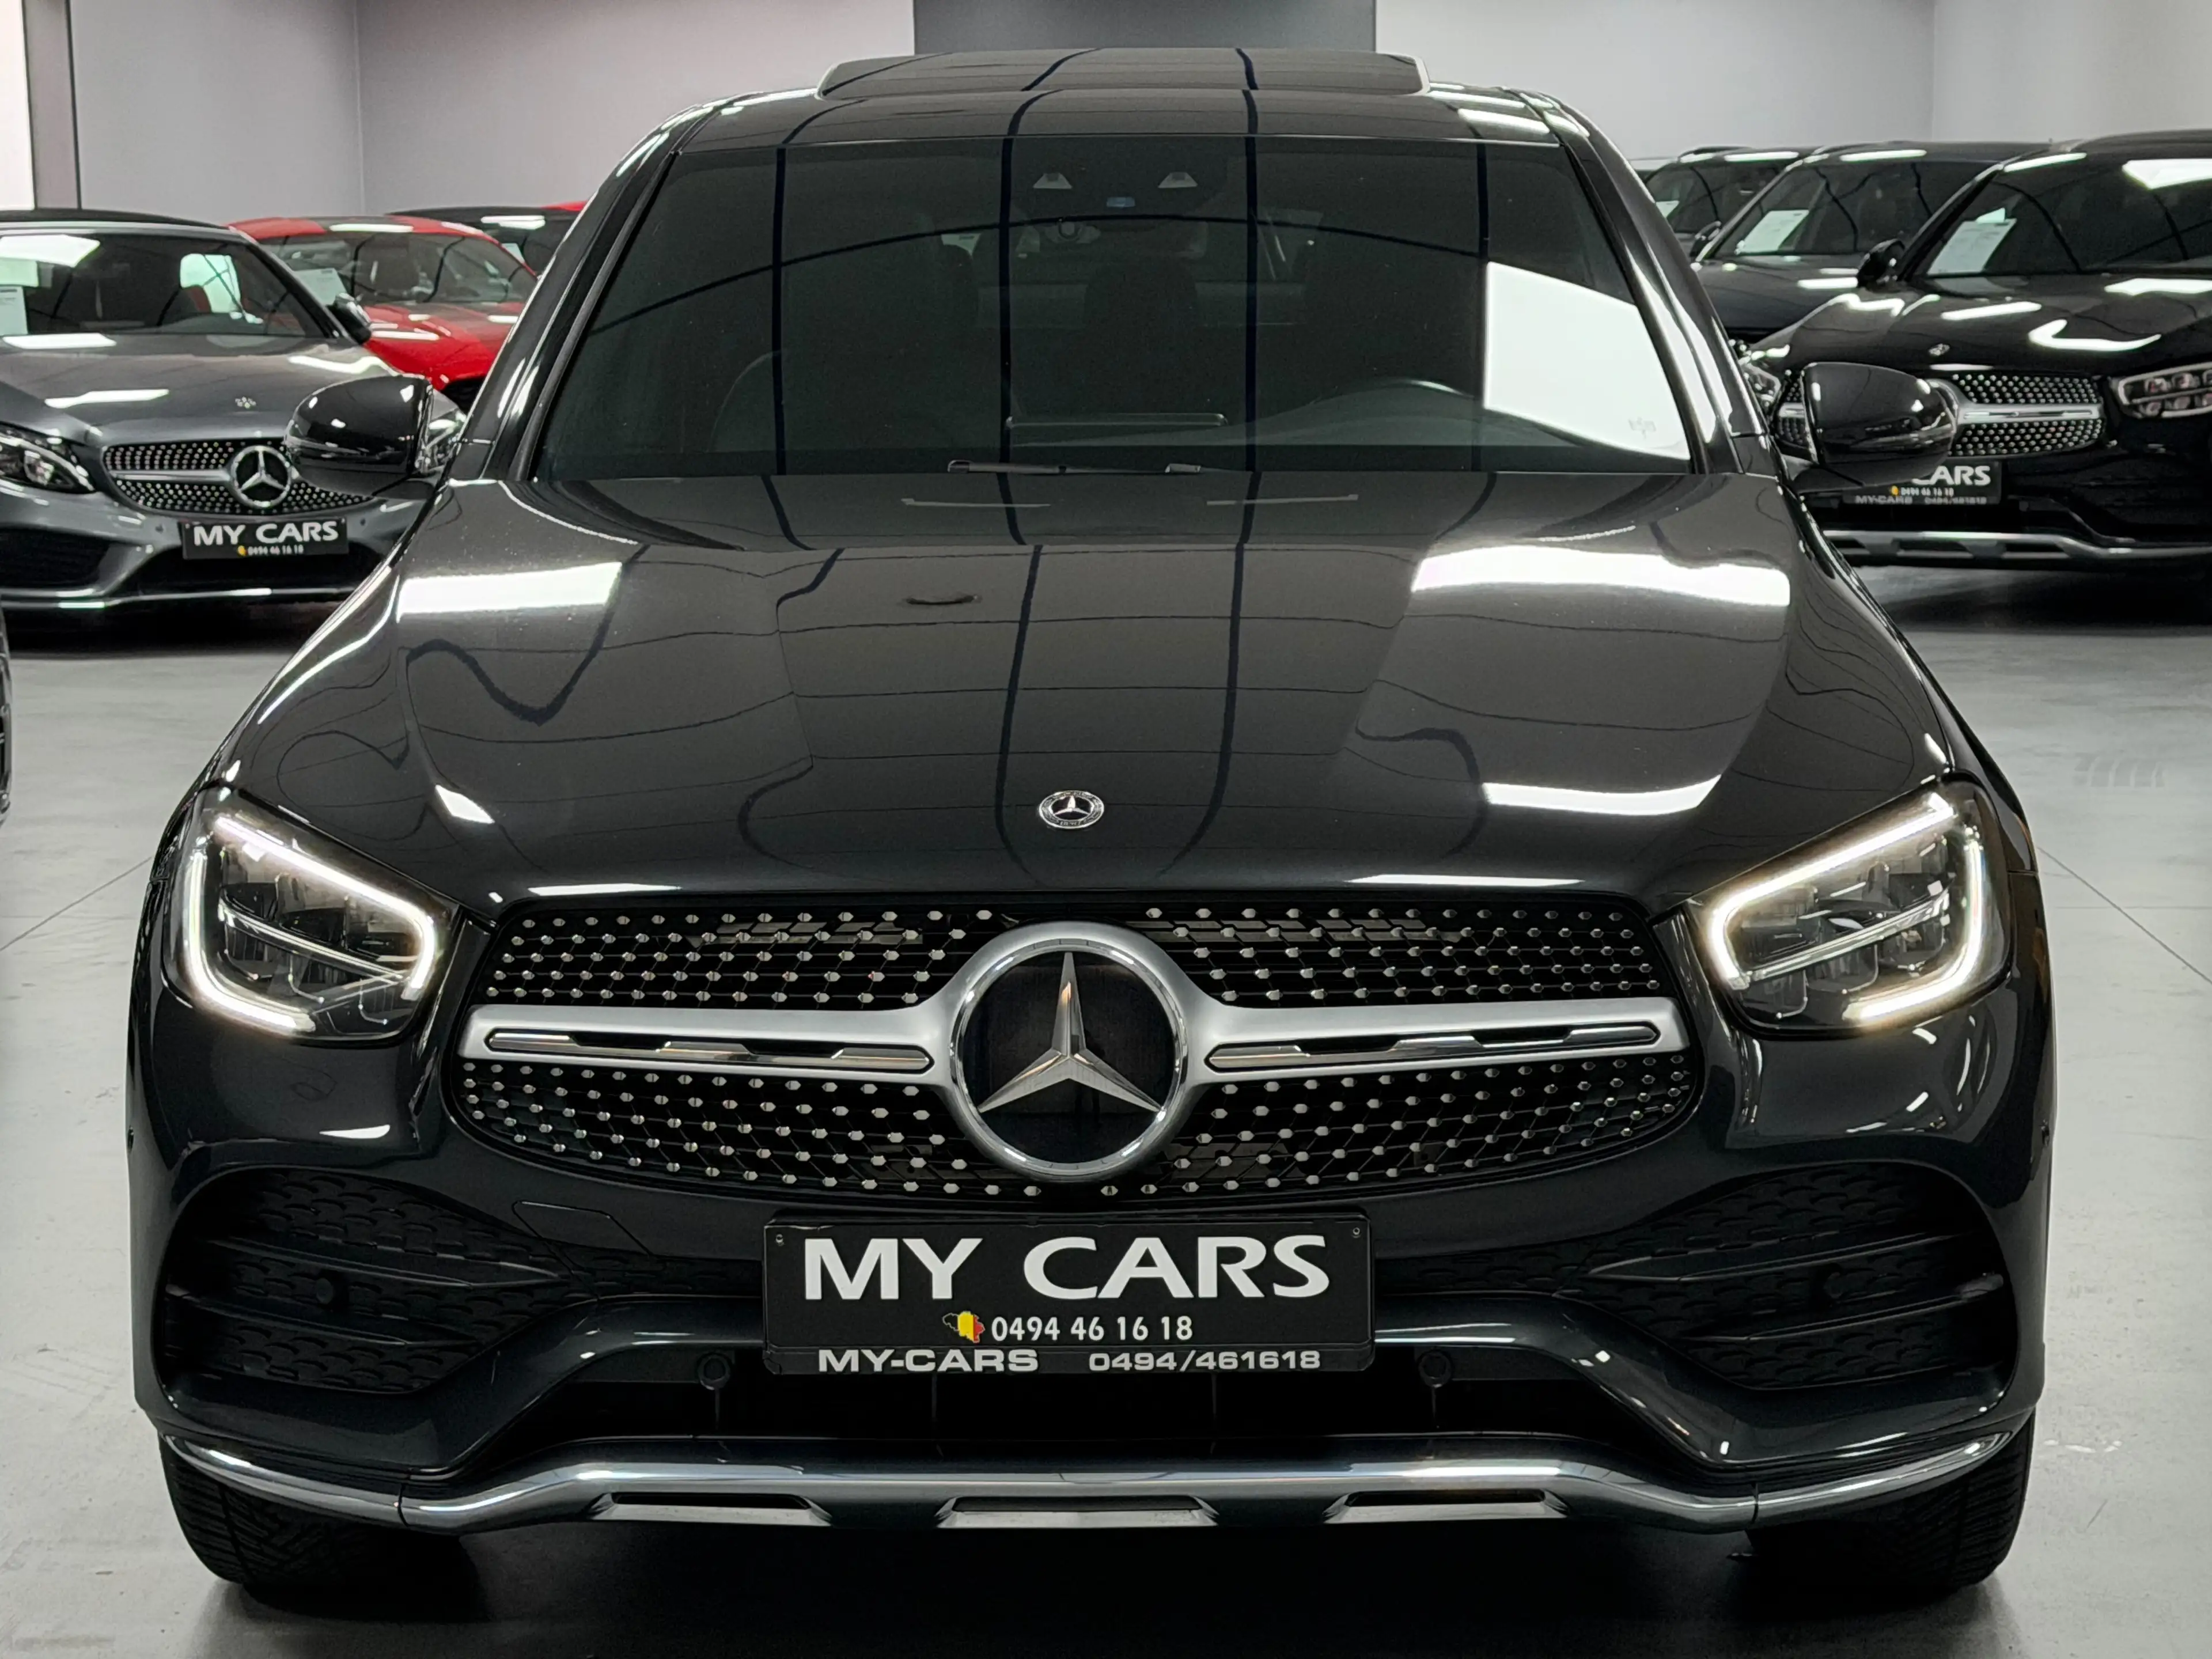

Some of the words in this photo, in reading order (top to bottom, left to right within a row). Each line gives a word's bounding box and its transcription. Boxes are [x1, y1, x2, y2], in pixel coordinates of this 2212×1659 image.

[194, 525, 246, 546] MY
[256, 521, 339, 543] CARS
[805, 1238, 983, 1300] MY
[1024, 1234, 1330, 1300] CARS
[991, 1316, 1060, 1342] 0494
[1070, 1316, 1104, 1341] 46
[1117, 1316, 1149, 1341] 16
[1161, 1316, 1192, 1340] 18
[819, 1349, 1039, 1372] MY-CARS
[1089, 1350, 1320, 1371] 0494/461618
